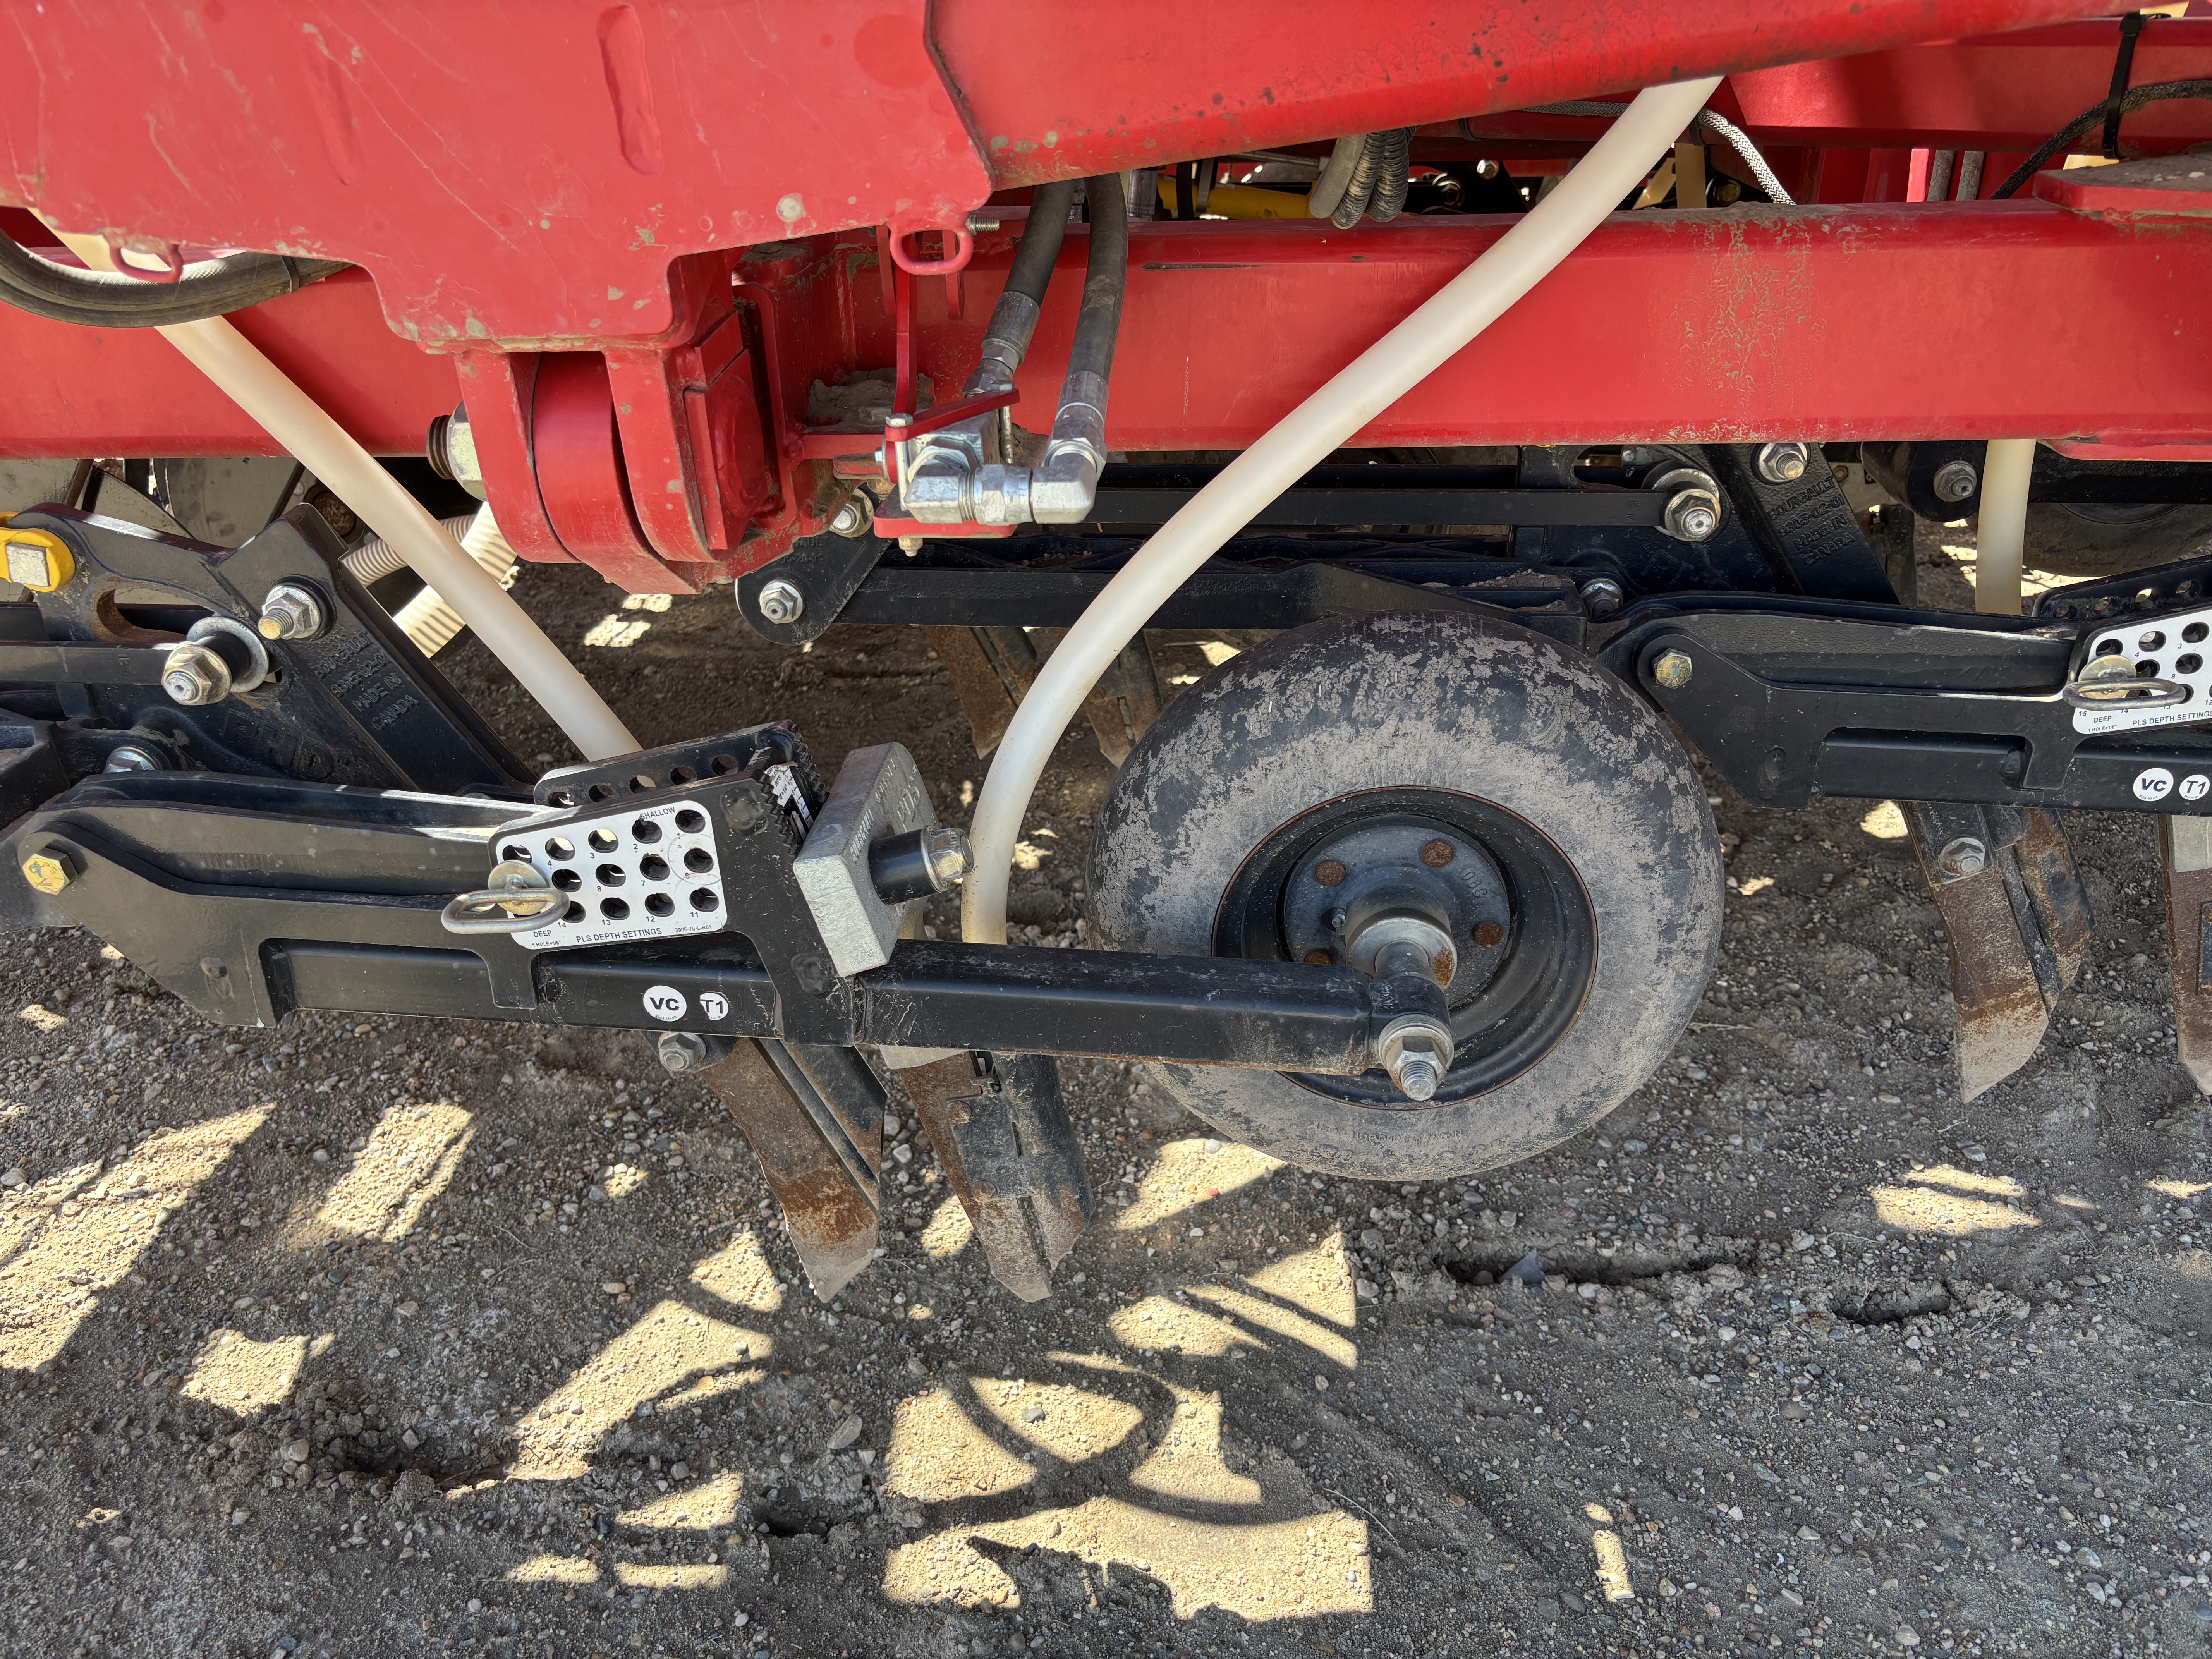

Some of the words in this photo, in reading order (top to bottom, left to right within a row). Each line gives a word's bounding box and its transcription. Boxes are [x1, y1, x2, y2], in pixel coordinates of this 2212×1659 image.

[1767, 476, 1835, 520] BOURGAULT
[1793, 523, 1830, 549] MADE
[1831, 514, 1848, 530] IN
[1804, 532, 1856, 565] CANADA
[311, 631, 372, 678] BOURGAULT
[352, 683, 390, 713] MADE
[384, 673, 402, 690] IN
[372, 695, 418, 730] CANADA
[2149, 715, 2174, 724] DEPTH
[2142, 778, 2167, 792] VC
[2186, 780, 2206, 794] T1
[639, 807, 675, 819] SHALLOW
[594, 932, 620, 941] DEPTH
[622, 928, 662, 938] SETTINGS
[649, 997, 680, 1011] VC
[701, 999, 723, 1014] T1
